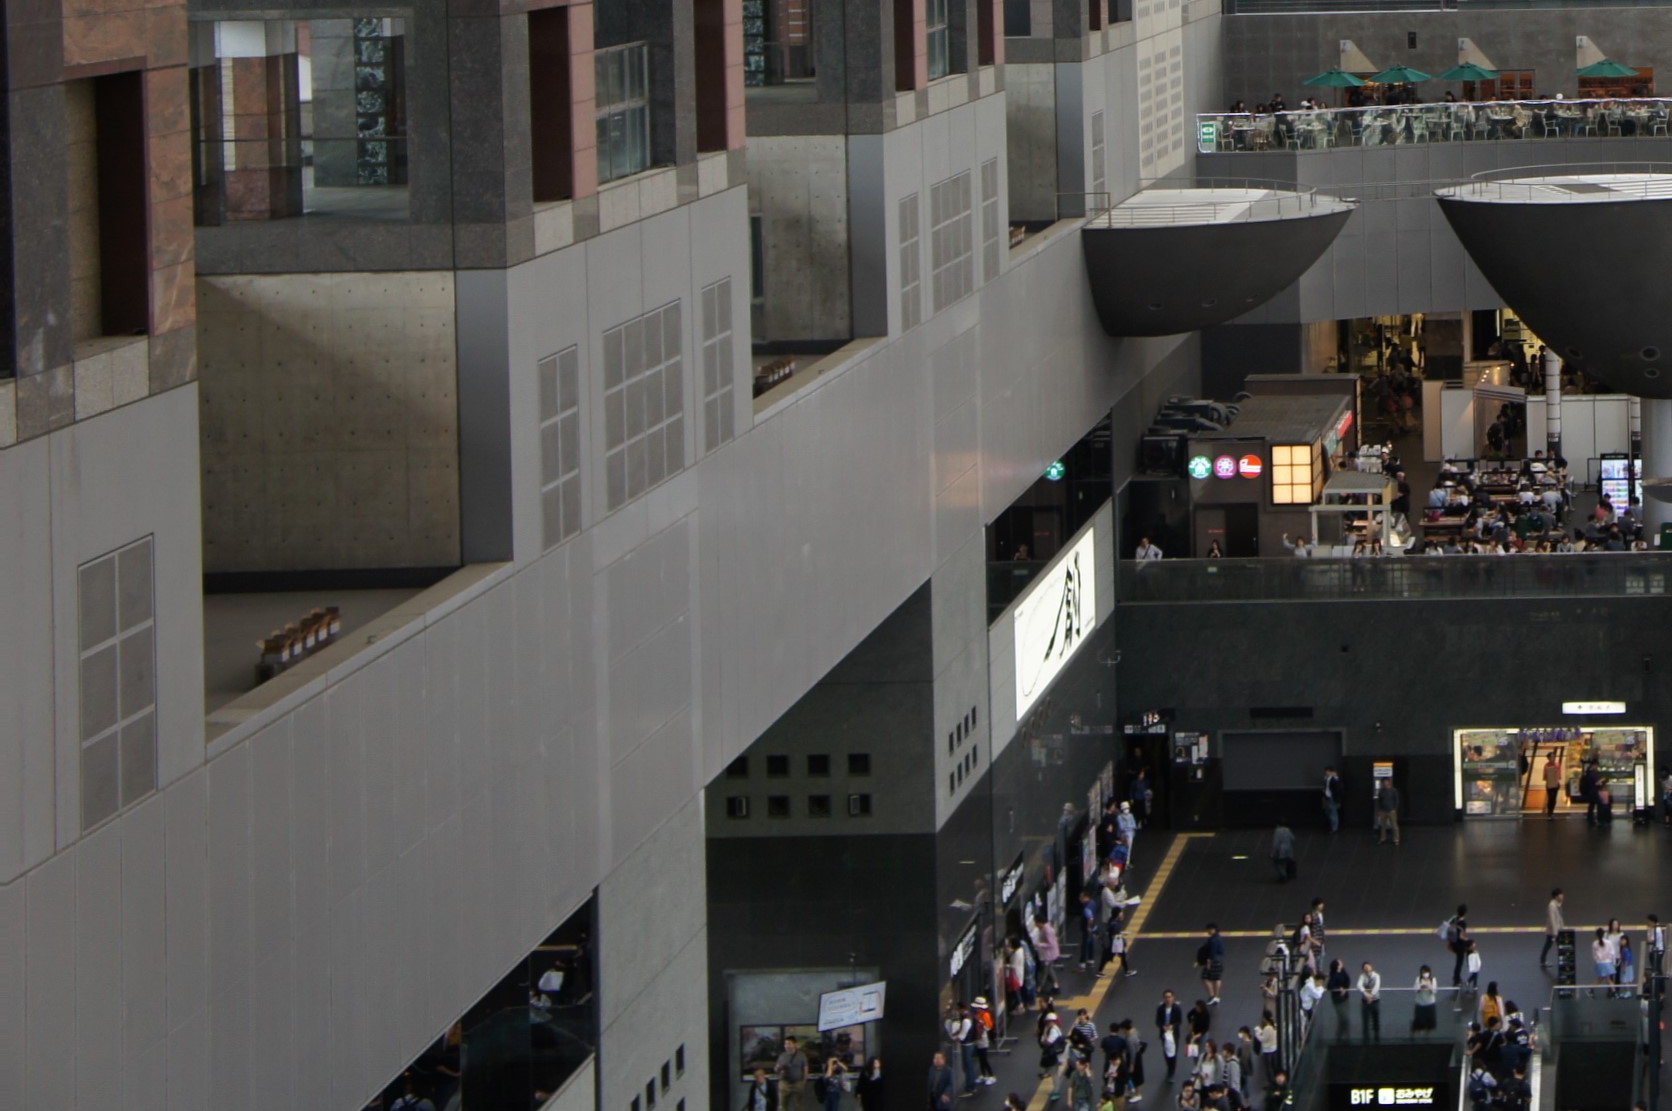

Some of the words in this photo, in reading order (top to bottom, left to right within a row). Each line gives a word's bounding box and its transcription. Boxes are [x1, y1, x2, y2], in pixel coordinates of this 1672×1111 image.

[1351, 1089, 1374, 1104] B1F
[1395, 1088, 1433, 1098] おみやげ
